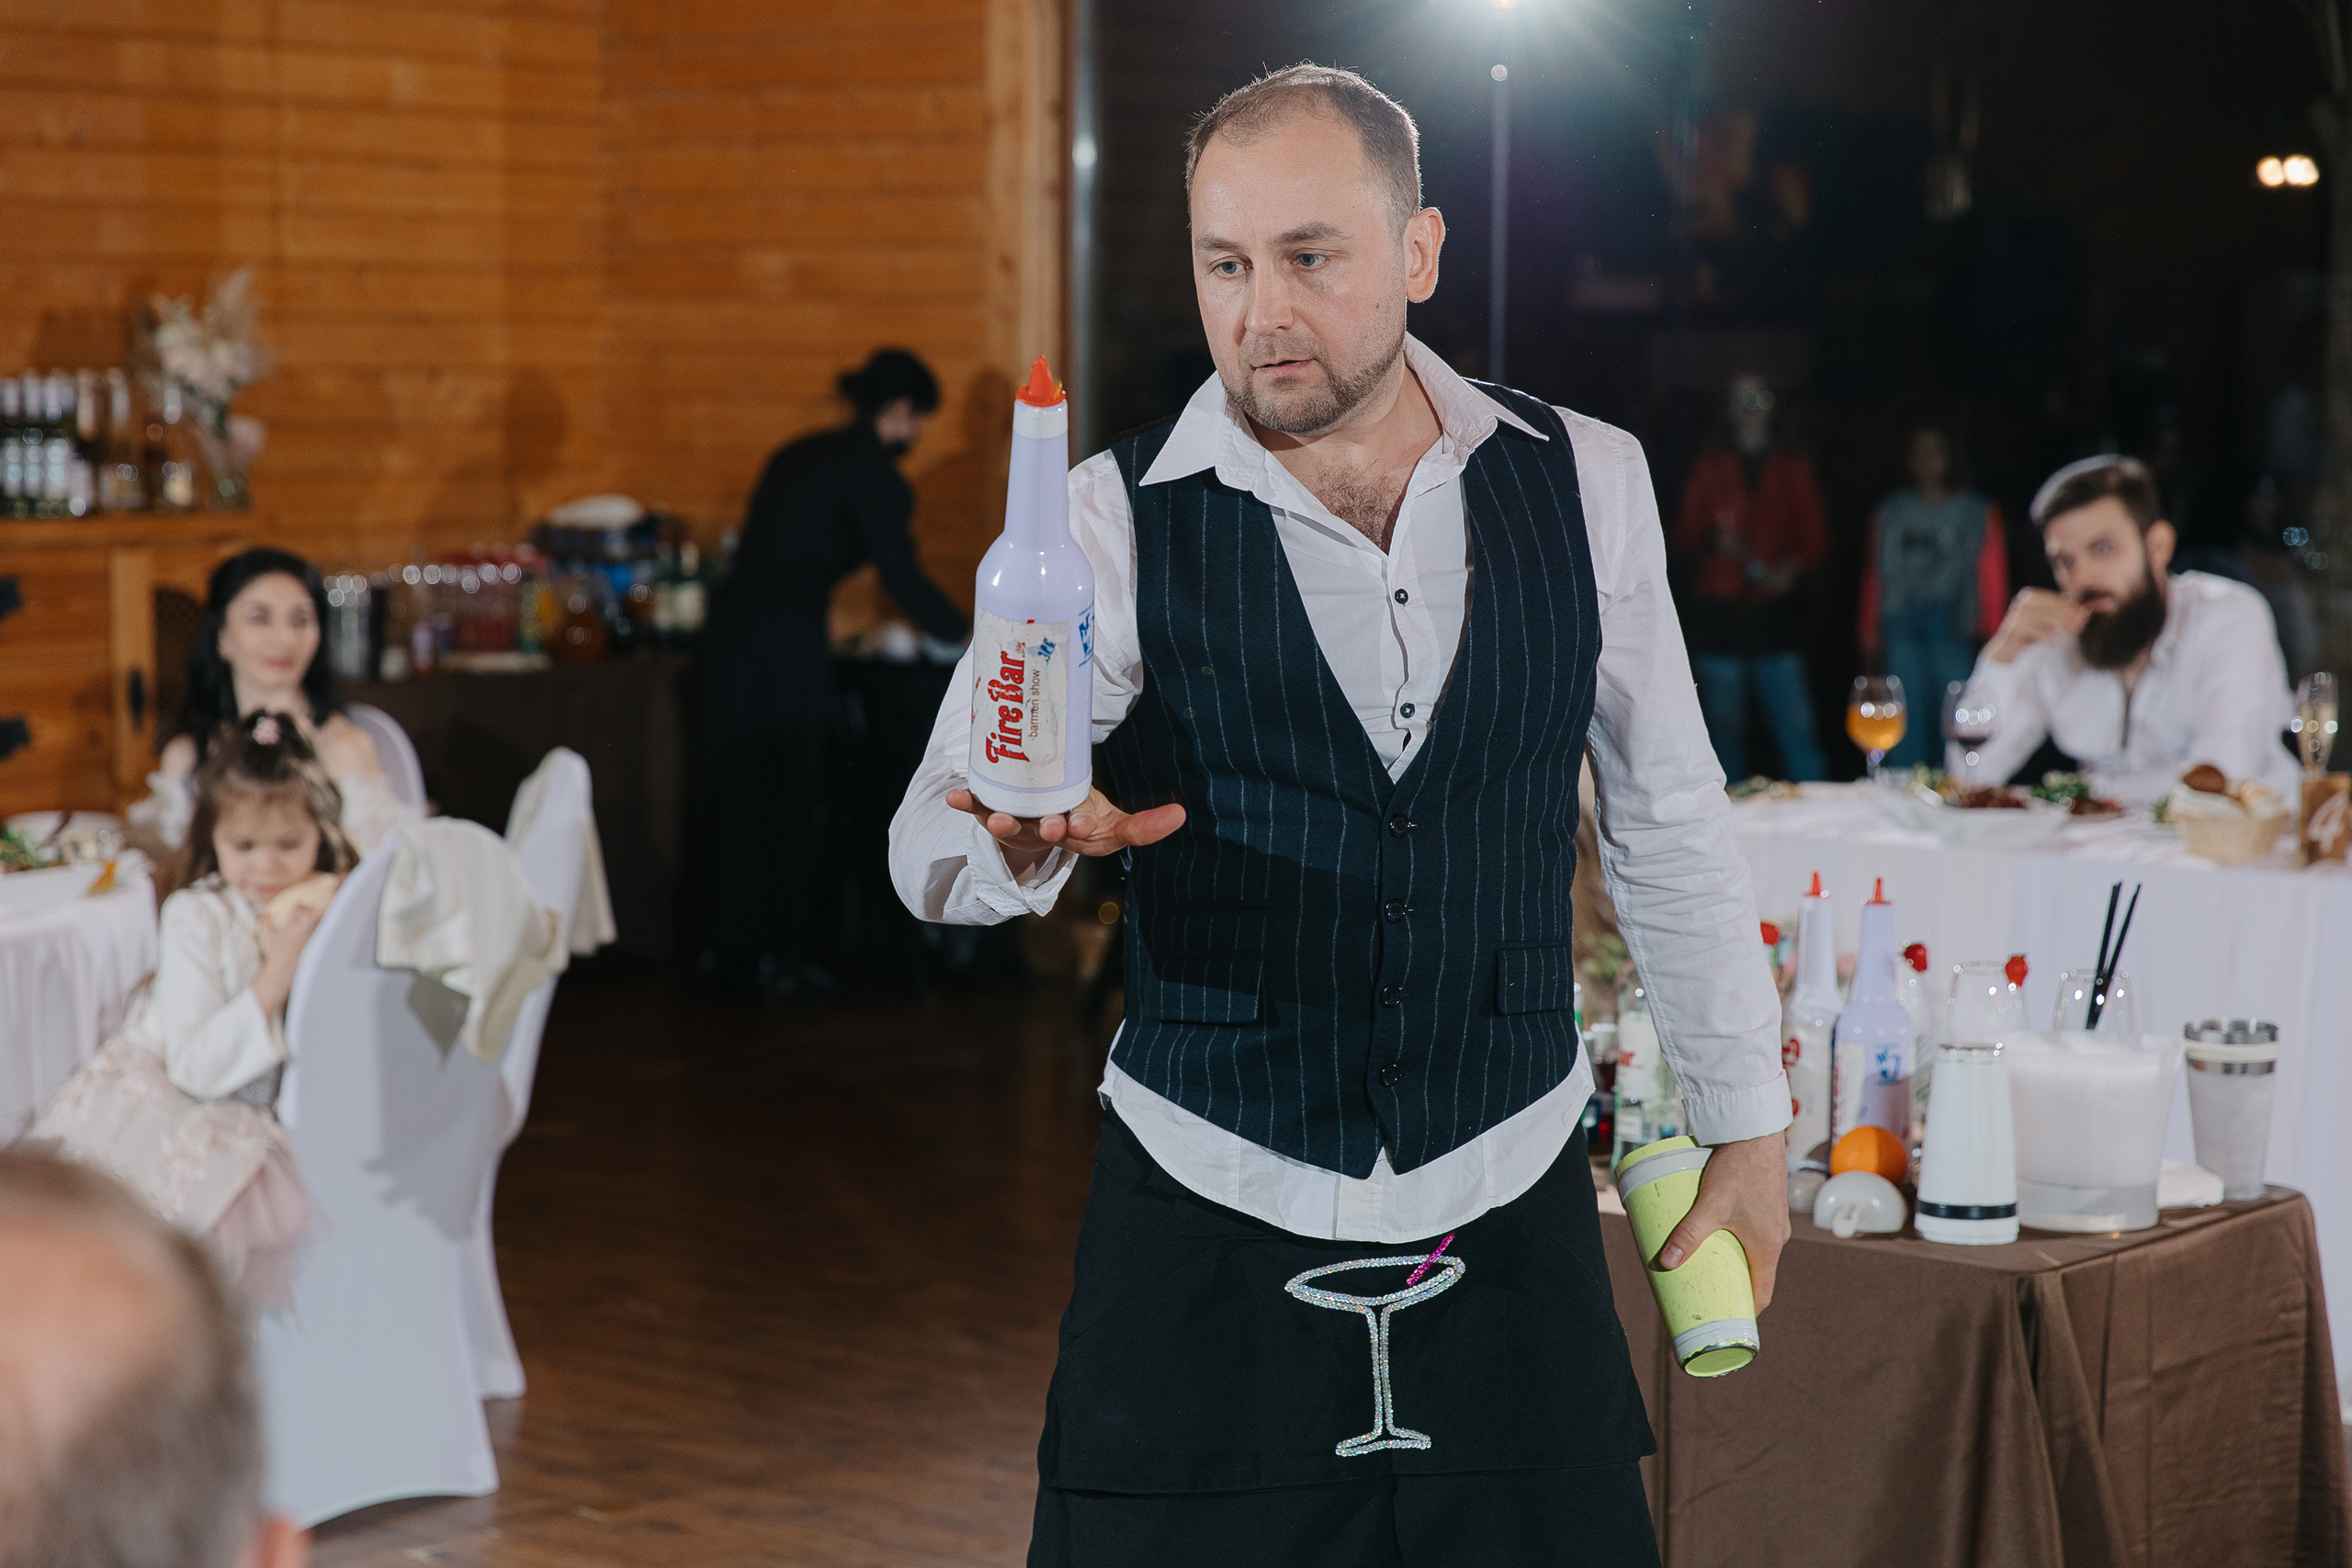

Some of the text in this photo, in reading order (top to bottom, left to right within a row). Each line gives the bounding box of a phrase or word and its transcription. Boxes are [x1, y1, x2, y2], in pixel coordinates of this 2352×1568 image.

[986, 650, 1030, 763] Fire Bar
[1028, 669, 1040, 738] barmen show
